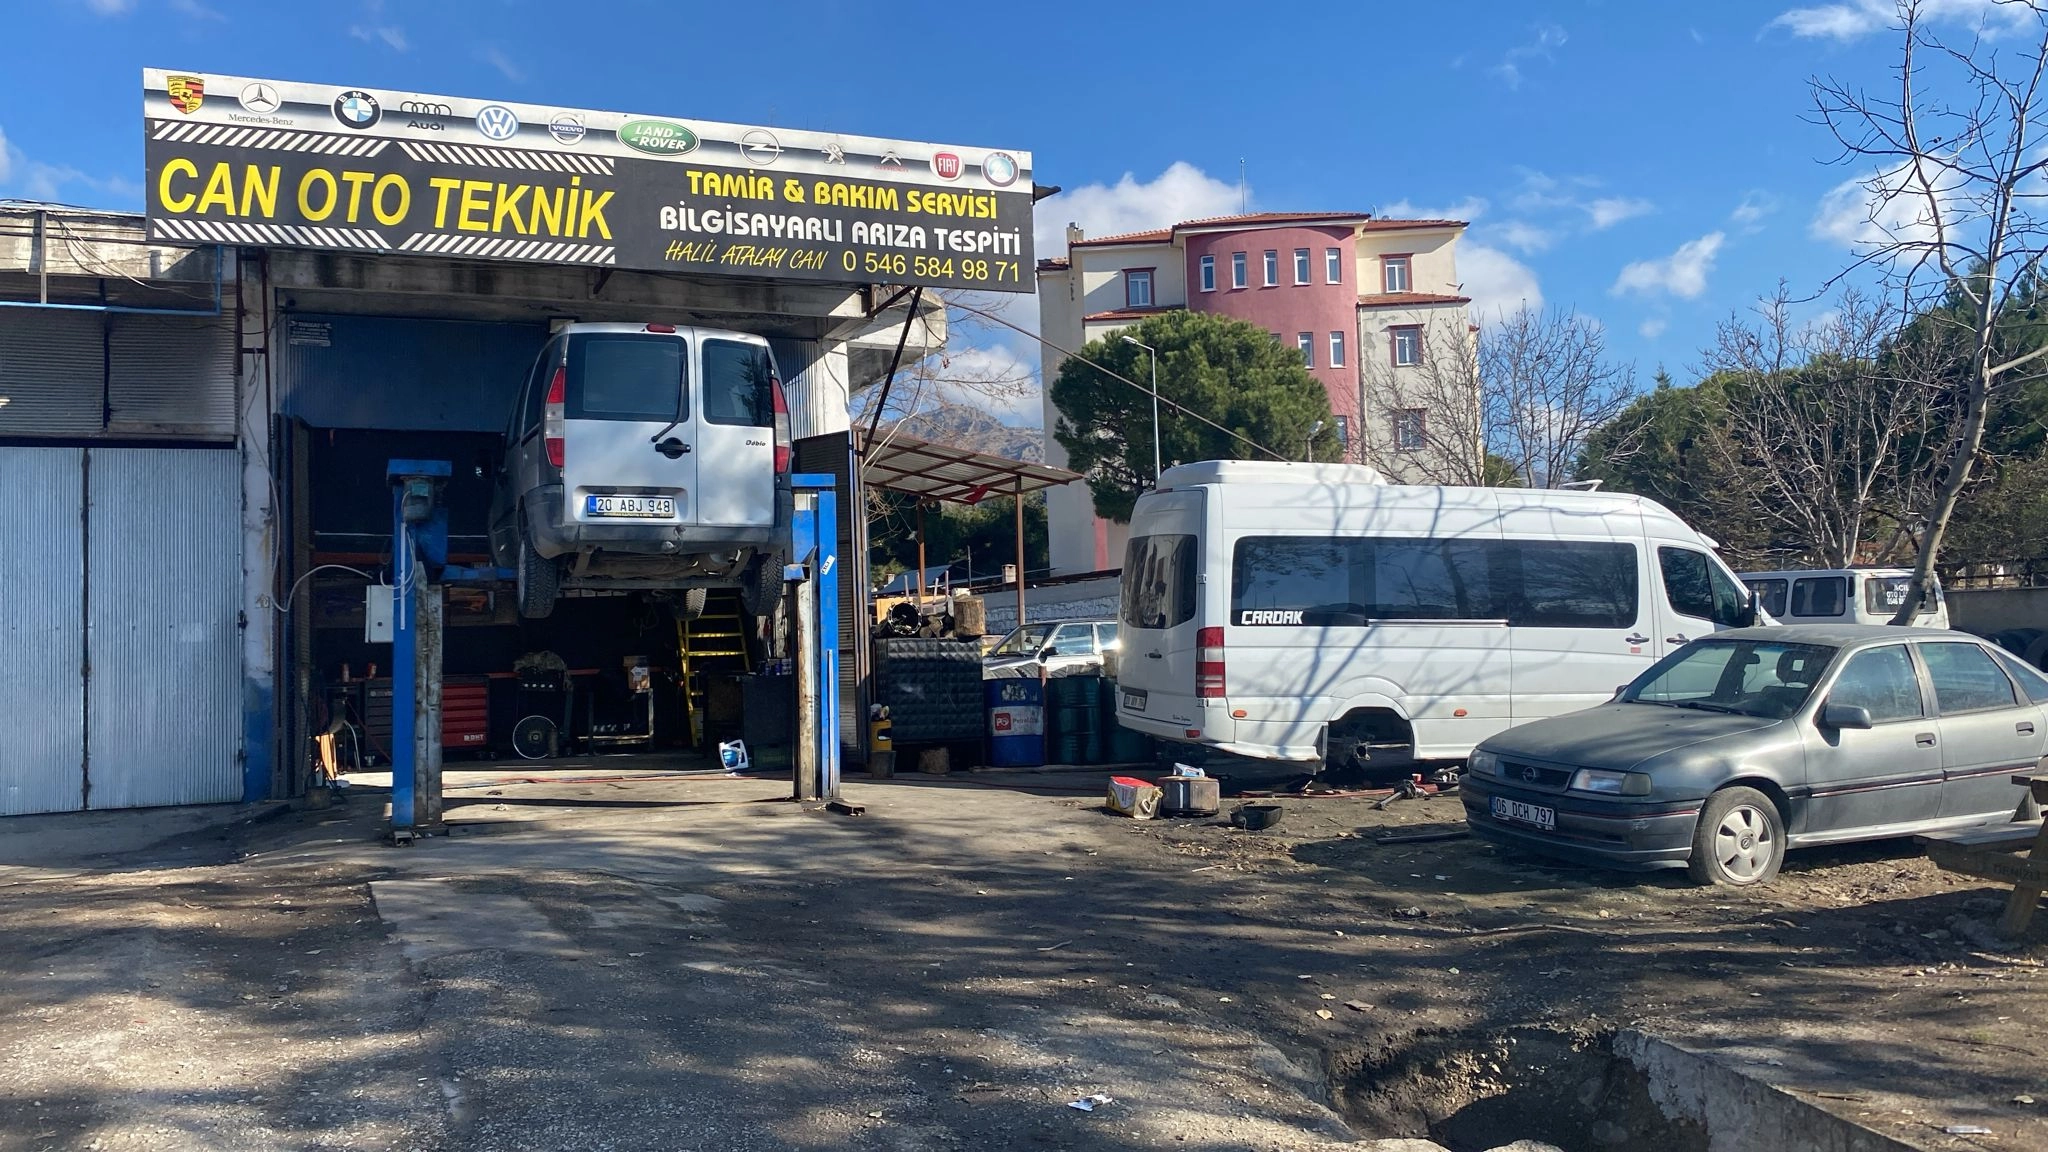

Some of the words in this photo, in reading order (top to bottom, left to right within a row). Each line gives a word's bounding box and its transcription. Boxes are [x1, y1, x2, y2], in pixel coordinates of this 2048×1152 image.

[338, 91, 378, 107] BMW
[228, 114, 294, 126] Mercedes-Benz
[407, 120, 445, 131] Audi
[552, 124, 584, 133] VOLVO
[635, 125, 674, 138] LAND
[639, 136, 687, 150] ROVER
[937, 157, 958, 173] FIAT
[159, 158, 281, 218] CAN
[298, 168, 410, 226] OTO
[430, 176, 616, 240] TEKNİK
[686, 169, 774, 201] TAMİR
[783, 179, 806, 204] &
[814, 181, 900, 212] BAKIM
[907, 188, 997, 219] SERVİSİ
[660, 200, 843, 243] BİLGİSAYARLI
[852, 221, 927, 250] ARIZA
[933, 225, 1021, 256] TESPİTİ
[720, 245, 788, 269] ATALAY
[789, 249, 829, 270] CAN
[843, 250, 857, 272] 0
[864, 251, 906, 275] 546
[914, 256, 955, 279] 584
[961, 259, 988, 281] 98
[995, 261, 1019, 282] 71
[597, 498, 612, 511] 20
[620, 499, 643, 512] ABJ
[648, 499, 670, 513] 948
[1496, 798, 1507, 814] 06
[1511, 802, 1530, 820] DCH
[1534, 807, 1553, 824] 797
